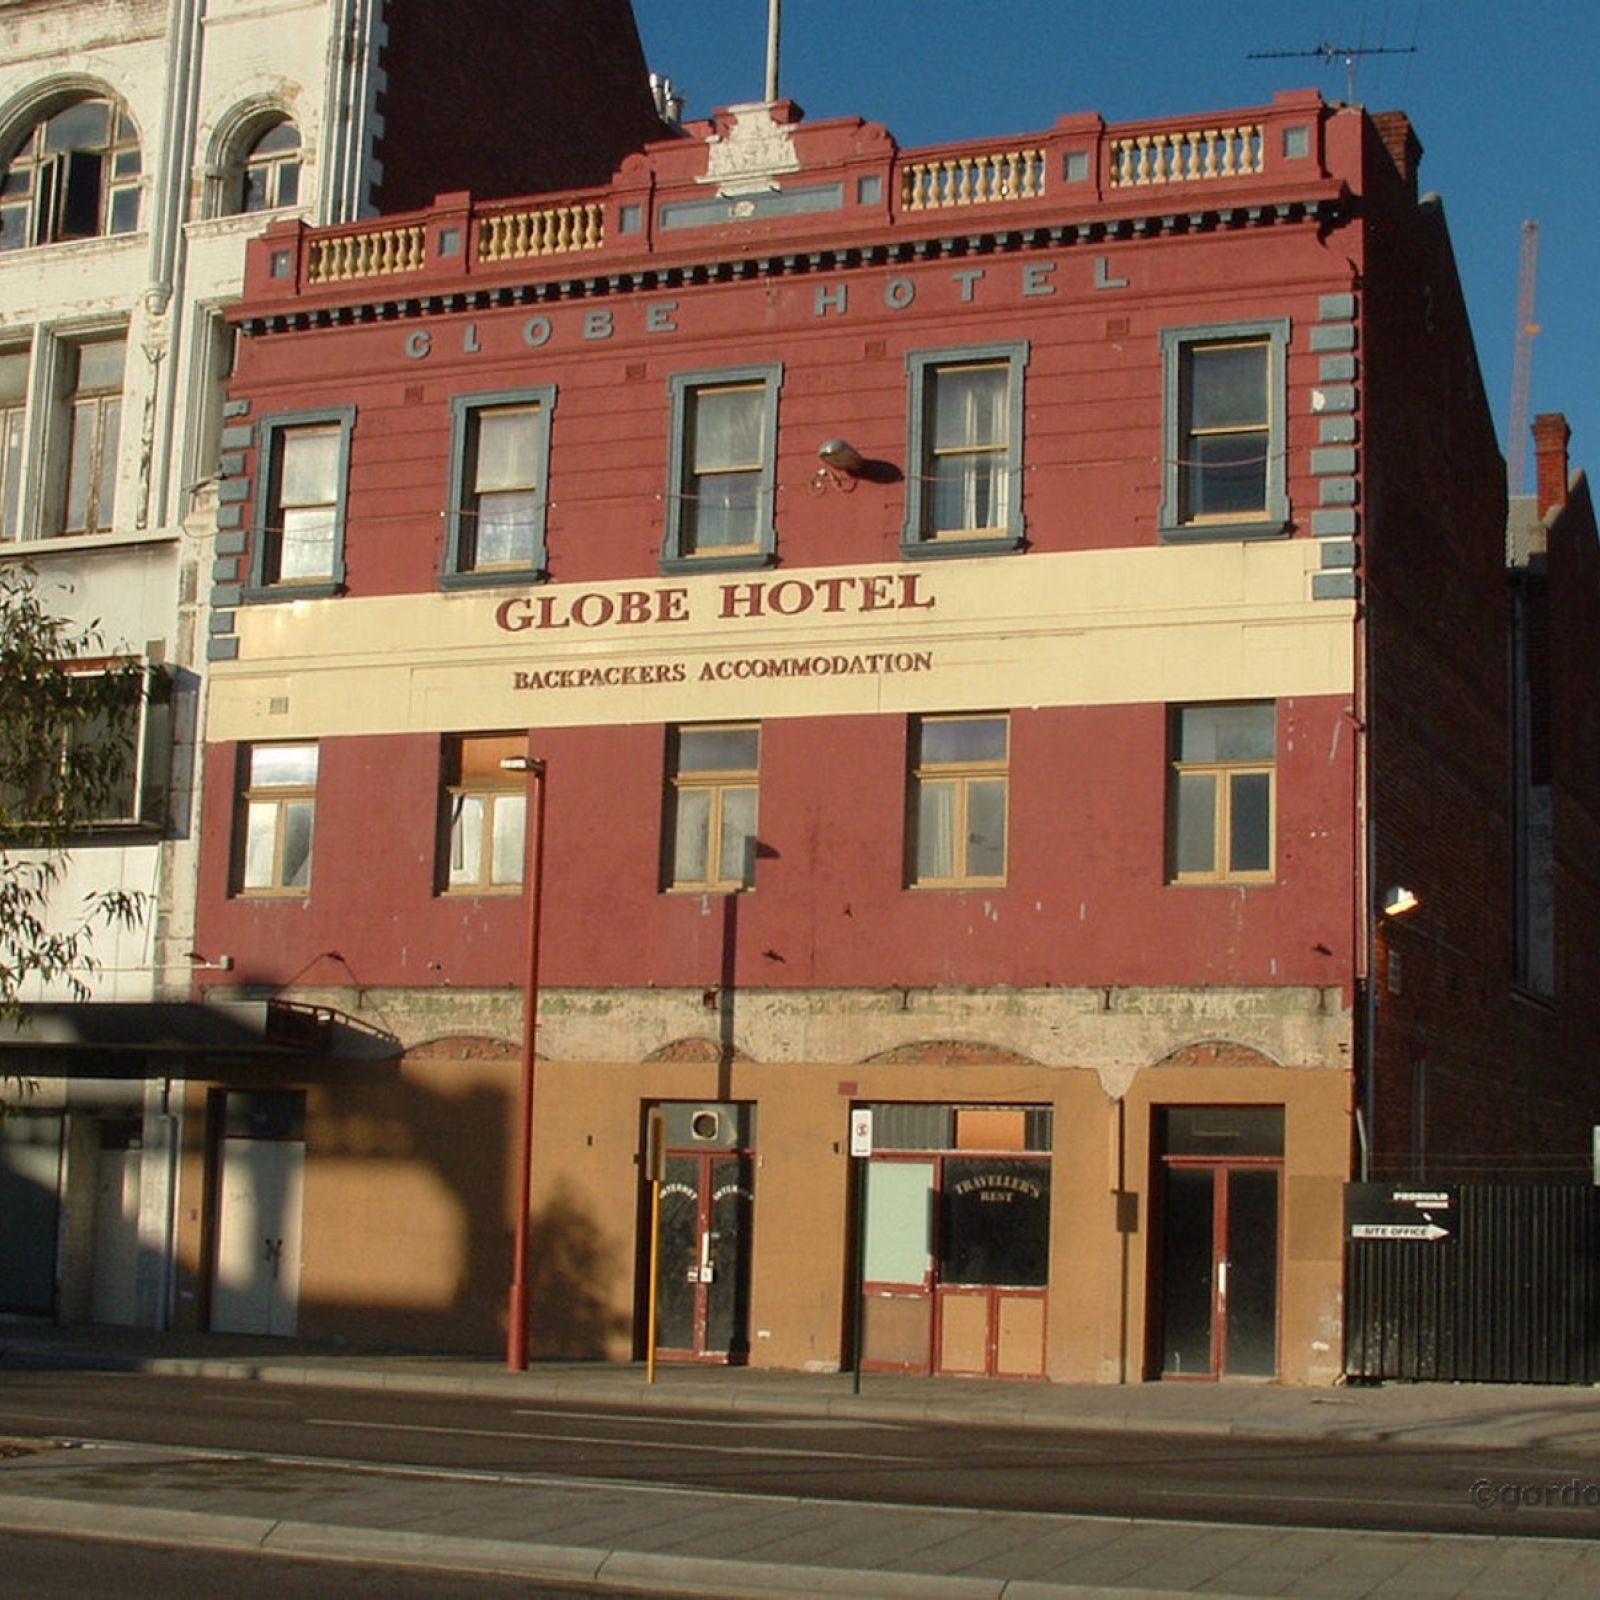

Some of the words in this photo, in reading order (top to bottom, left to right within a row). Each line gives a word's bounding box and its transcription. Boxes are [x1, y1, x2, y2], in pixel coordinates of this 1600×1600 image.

[404, 302, 679, 359] GLOBE
[813, 256, 1130, 317] HOTEL
[496, 588, 690, 632] GLOBE
[718, 574, 936, 619] HOTEL
[513, 663, 686, 690] BACKPACKERS
[699, 651, 933, 681] ACCOMMODATION
[713, 1184, 754, 1201] INTERT
[1364, 1226, 1387, 1236] SITE
[1390, 1226, 1427, 1236] OFFICE
